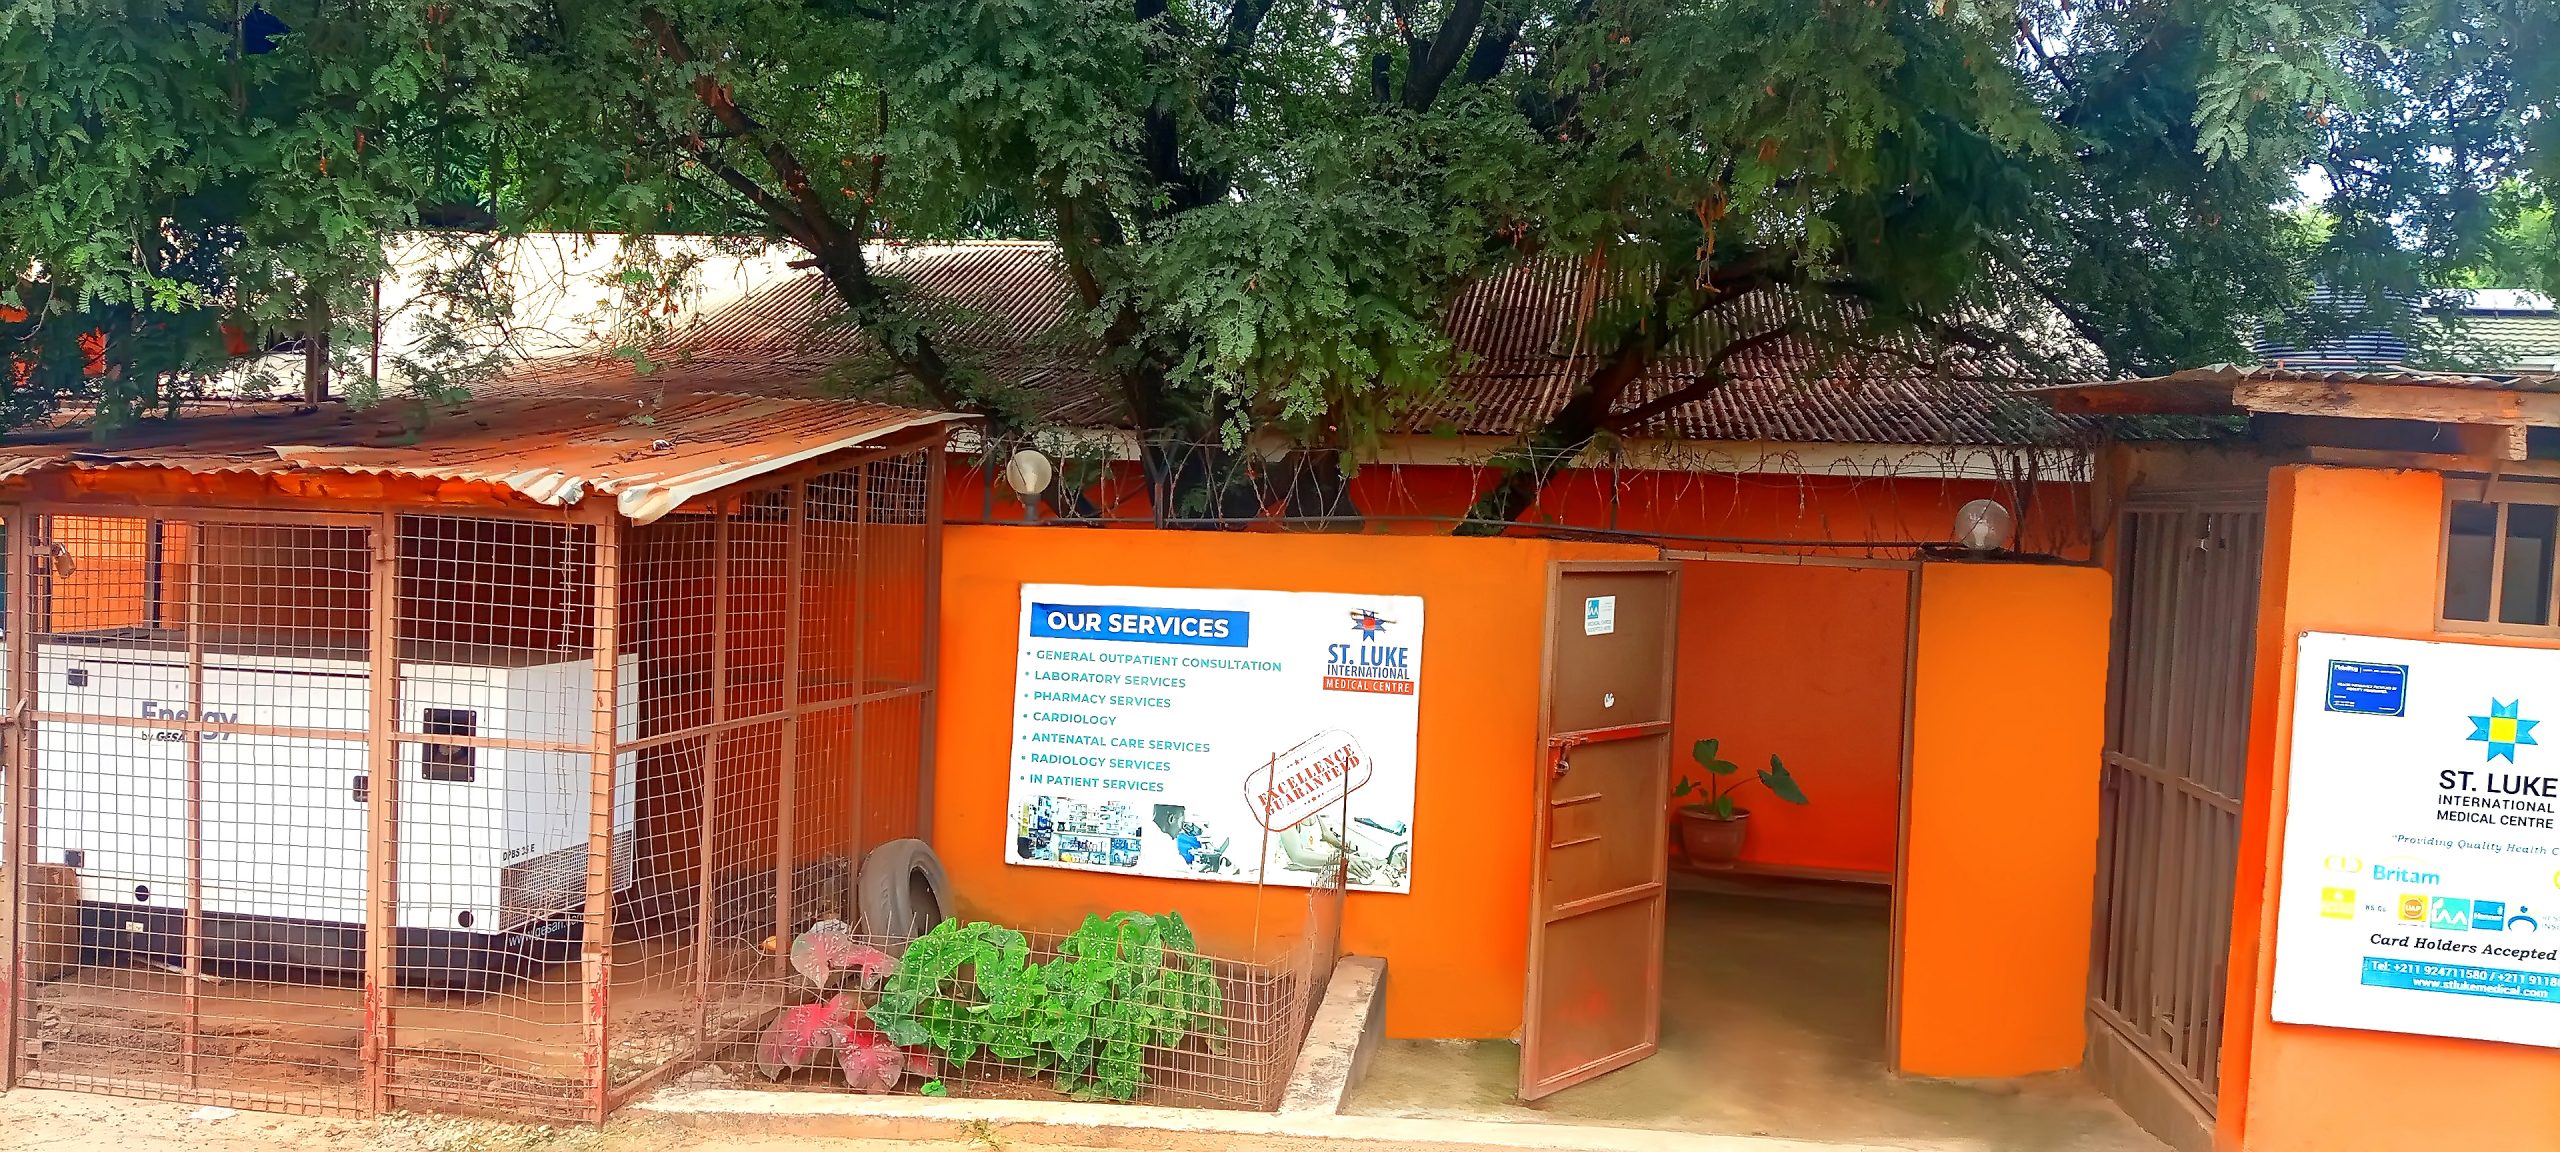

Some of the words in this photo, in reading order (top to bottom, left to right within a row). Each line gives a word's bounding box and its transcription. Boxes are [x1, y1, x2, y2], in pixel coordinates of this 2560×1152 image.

[1047, 611, 1101, 632] OUR
[1108, 613, 1229, 639] SERVICES
[1036, 650, 1096, 662] GENERAL
[1099, 653, 1178, 666] OUTPATIENT
[1182, 657, 1282, 672] CONSULTATION
[1327, 643, 1354, 665] ST.
[1360, 645, 1408, 668] LUKE
[1034, 670, 1121, 685] LABORATORY
[1124, 675, 1186, 688] SERVICES
[1327, 664, 1410, 680] INTERNATIONAL
[1326, 679, 1369, 691] MEDICAL
[1373, 682, 1410, 693] CENTRE
[1033, 691, 1106, 704] PHARMACY
[1109, 695, 1171, 708] SERVICES
[142, 701, 238, 741] Enegy
[1033, 711, 1117, 726] CARDIOLOGY
[141, 730, 154, 742] by
[156, 731, 188, 743] GESA
[1031, 732, 1107, 746] ANTENATAL
[1110, 737, 1145, 749] CARE
[1148, 740, 1210, 753] SERVICES
[1031, 753, 1106, 767] RADIOLOGY
[1109, 758, 1171, 771] SERVICES
[1030, 773, 1043, 784] IN
[1047, 775, 1100, 788] PATIENT
[1103, 779, 1164, 792] SERVICES
[1257, 743, 1355, 806] EXCELLENCE
[2439, 769, 2477, 792] ST.
[2487, 773, 2559, 798] LUKE
[1265, 755, 1360, 816] GUARANTEED
[2438, 794, 2555, 814] INTERNATIONAL
[2436, 809, 2496, 825] MEDICAL
[2500, 815, 2554, 829] CENTRE
[530, 843, 536, 852] E
[2457, 839, 2502, 854] Quality
[2506, 843, 2547, 855] Health
[2373, 864, 2440, 885] Britam
[2370, 933, 2409, 948] Card
[2414, 937, 2478, 954] Holders
[2481, 944, 2558, 961] Accepted
[2371, 960, 2390, 972] Tel:
[2394, 963, 2421, 974] +211
[2424, 965, 2488, 981] 924711580
[2498, 972, 2526, 984] +211
[2528, 975, 2560, 987] 9118
[2412, 978, 2549, 998] www.stlukemedical.com
